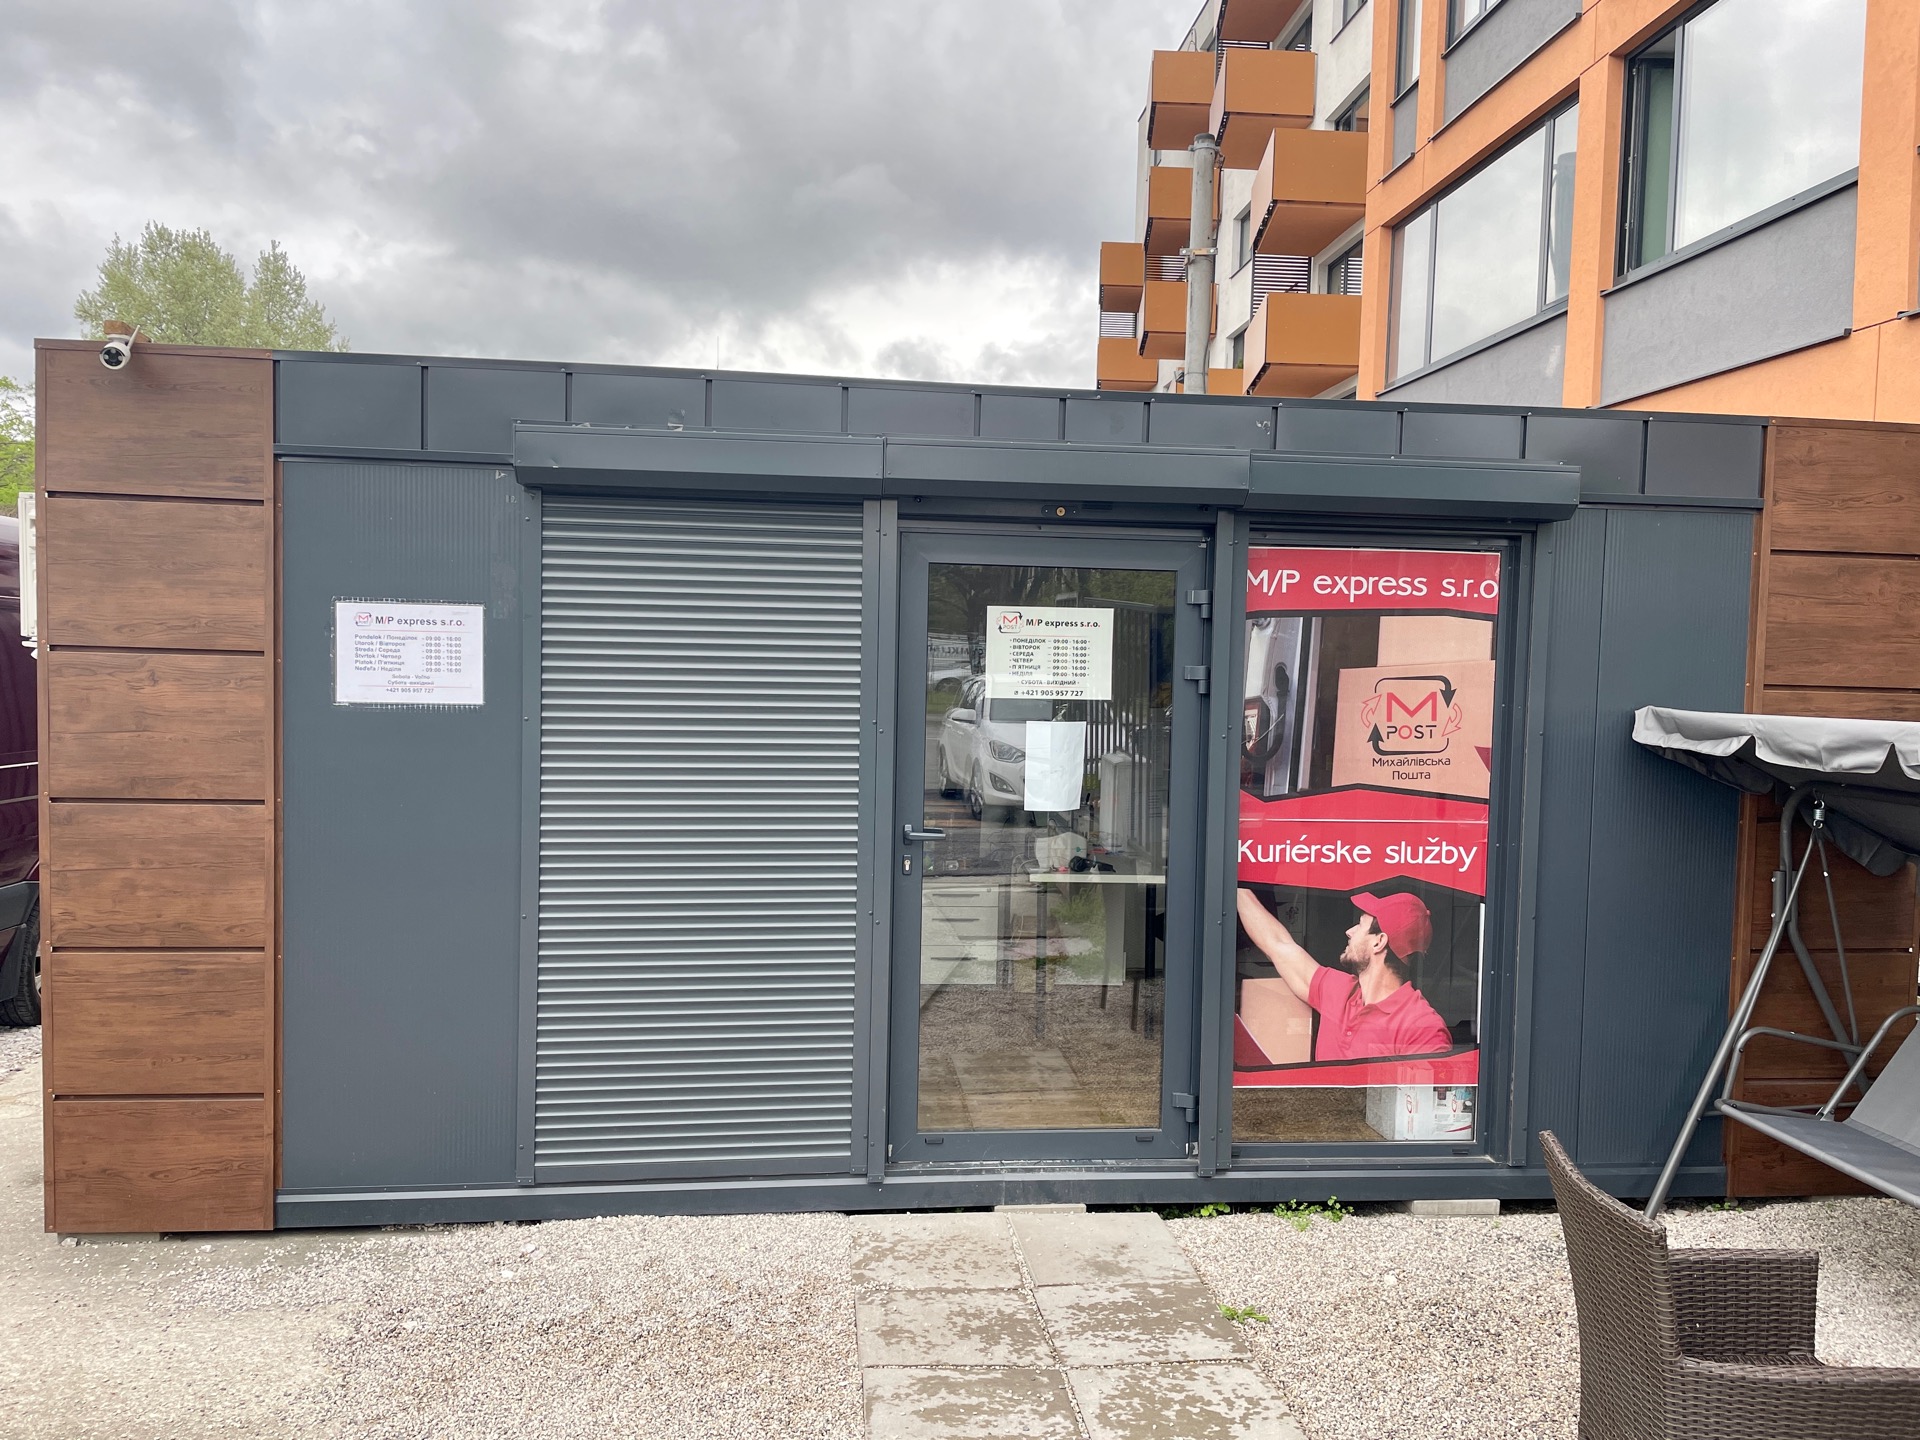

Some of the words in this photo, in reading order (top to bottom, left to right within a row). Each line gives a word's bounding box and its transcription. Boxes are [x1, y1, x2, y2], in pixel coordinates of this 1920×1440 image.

[1246, 569, 1300, 596] M/P
[1313, 574, 1428, 603] express
[375, 616, 394, 624] M/P
[397, 618, 437, 627] express
[1003, 615, 1018, 624] M
[1386, 691, 1438, 722] M
[1386, 724, 1437, 740] POST
[1372, 756, 1451, 768] Михайлівська
[1392, 770, 1431, 781] Пошта
[1238, 834, 1372, 864] Kuriérske
[1384, 837, 1477, 872] služby
